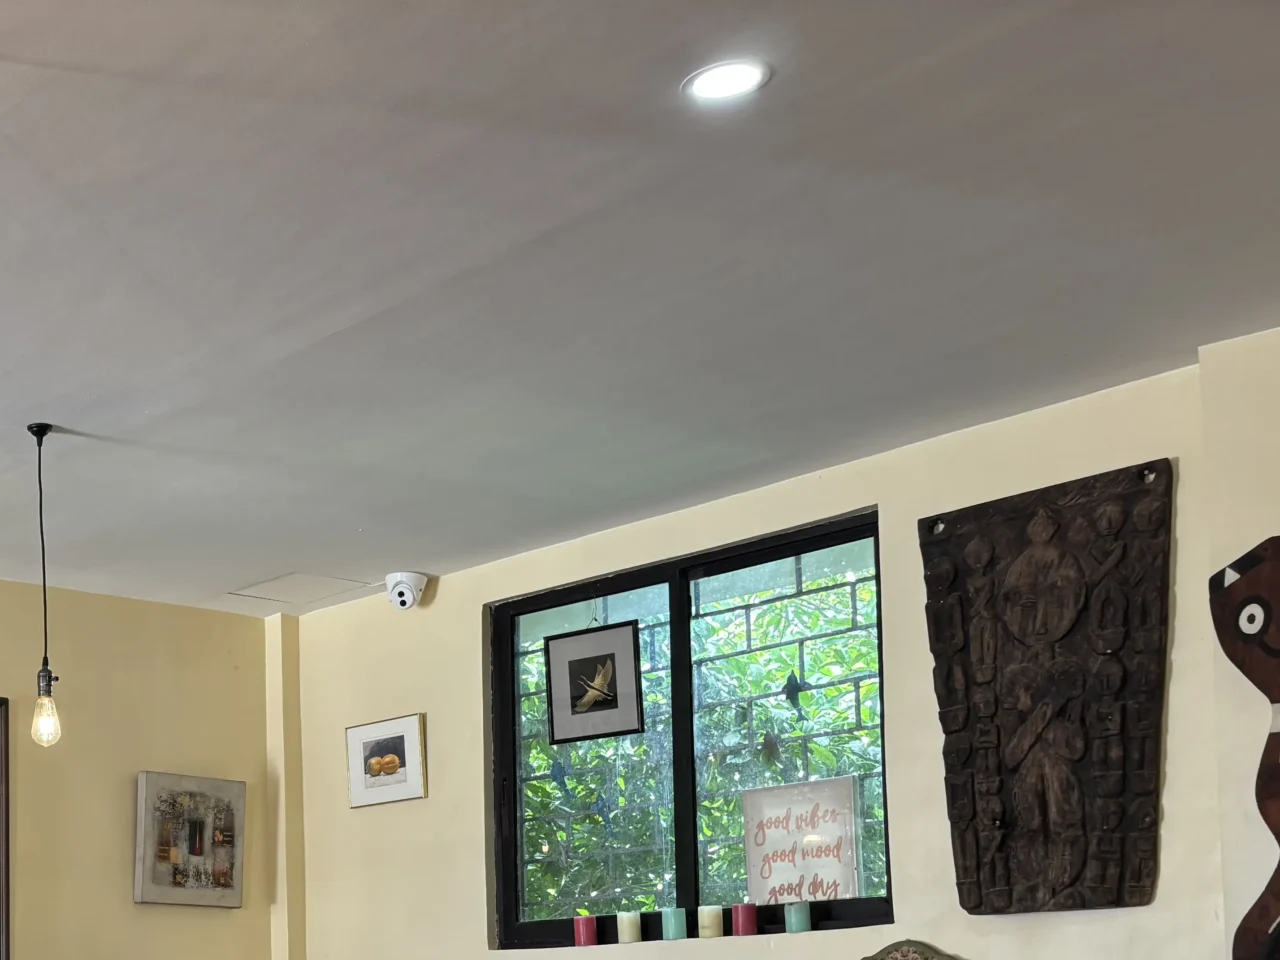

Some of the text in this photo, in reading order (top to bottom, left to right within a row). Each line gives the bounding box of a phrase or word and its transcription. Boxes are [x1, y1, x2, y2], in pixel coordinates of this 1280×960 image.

[754, 802, 842, 847] good vibes
[760, 835, 843, 880] good mood
[767, 872, 840, 905] good day
